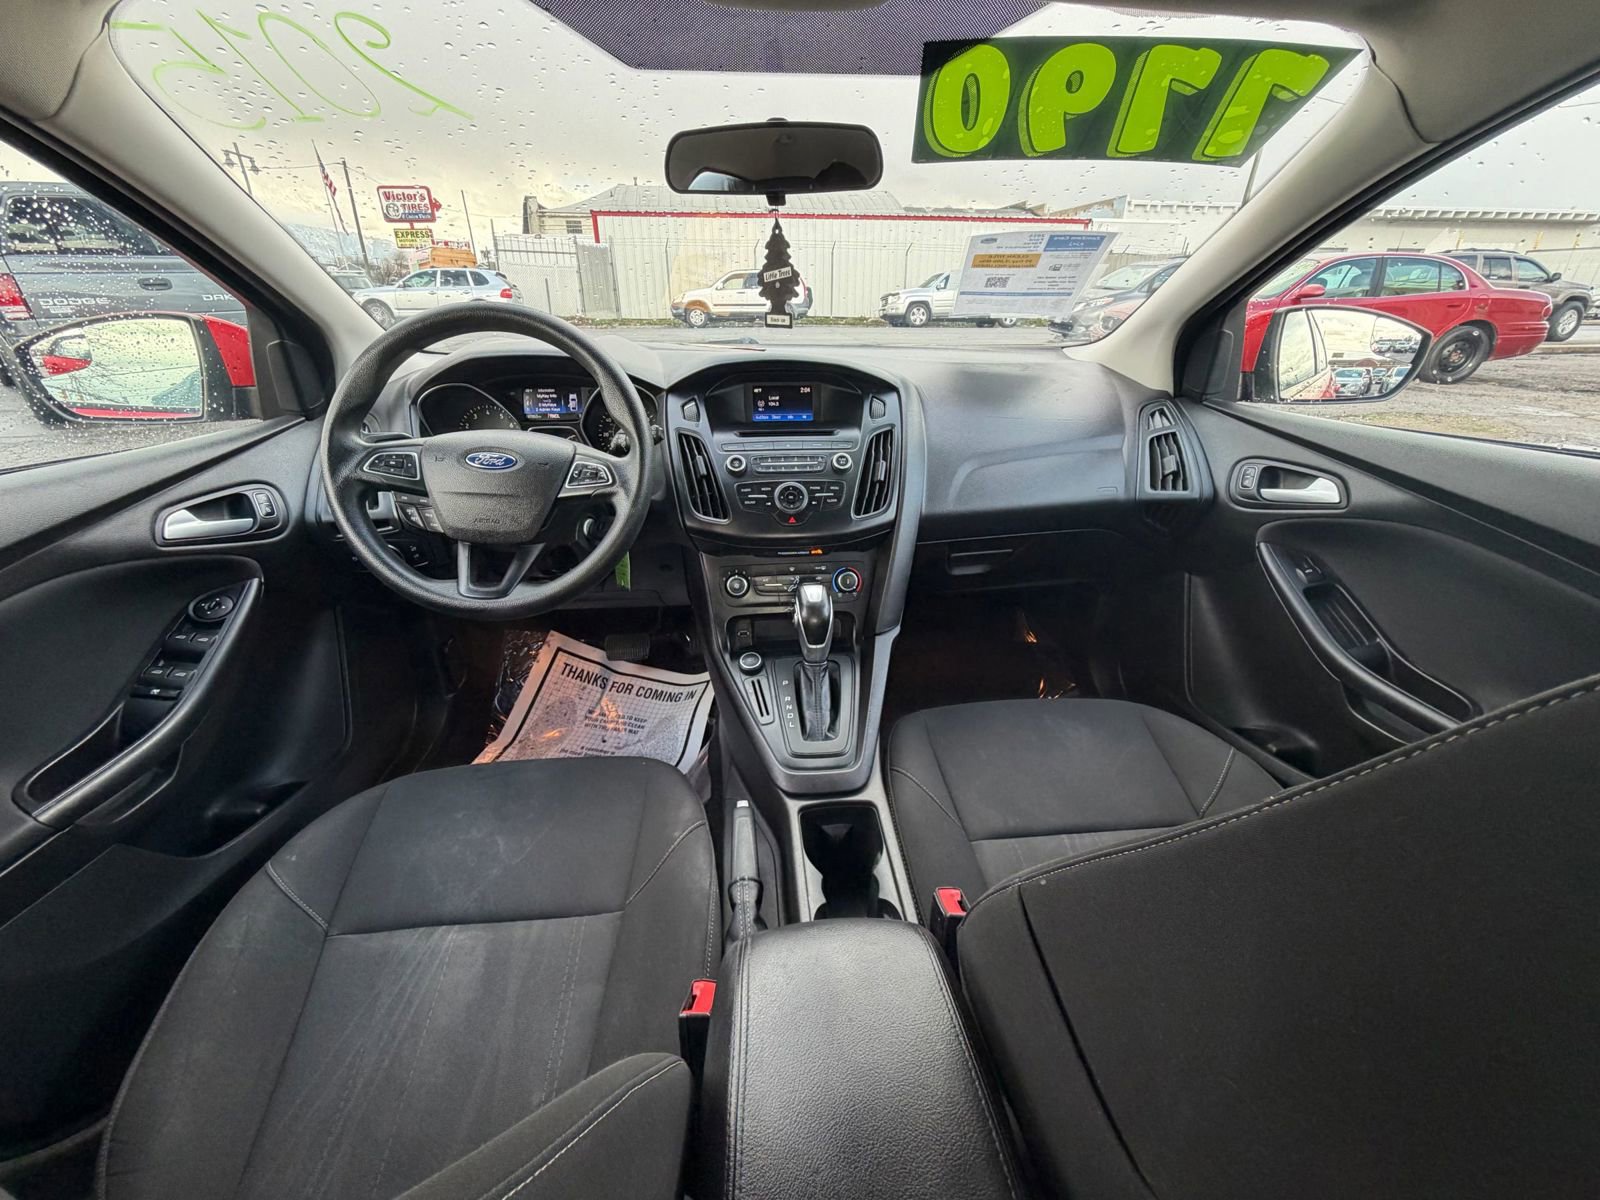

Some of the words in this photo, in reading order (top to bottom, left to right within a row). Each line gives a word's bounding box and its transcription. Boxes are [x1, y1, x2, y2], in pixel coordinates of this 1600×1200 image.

[382, 190, 427, 201] Victor's
[400, 203, 430, 212] TIRES
[396, 230, 430, 239] EXPRESS
[765, 272, 778, 281] Little
[778, 269, 791, 279] Trees
[38, 297, 110, 306] DODGE
[474, 452, 506, 466] Ford
[561, 662, 608, 690] THANKS
[608, 681, 634, 695] FOR
[635, 686, 683, 702] COMING
[685, 690, 697, 700] IN
